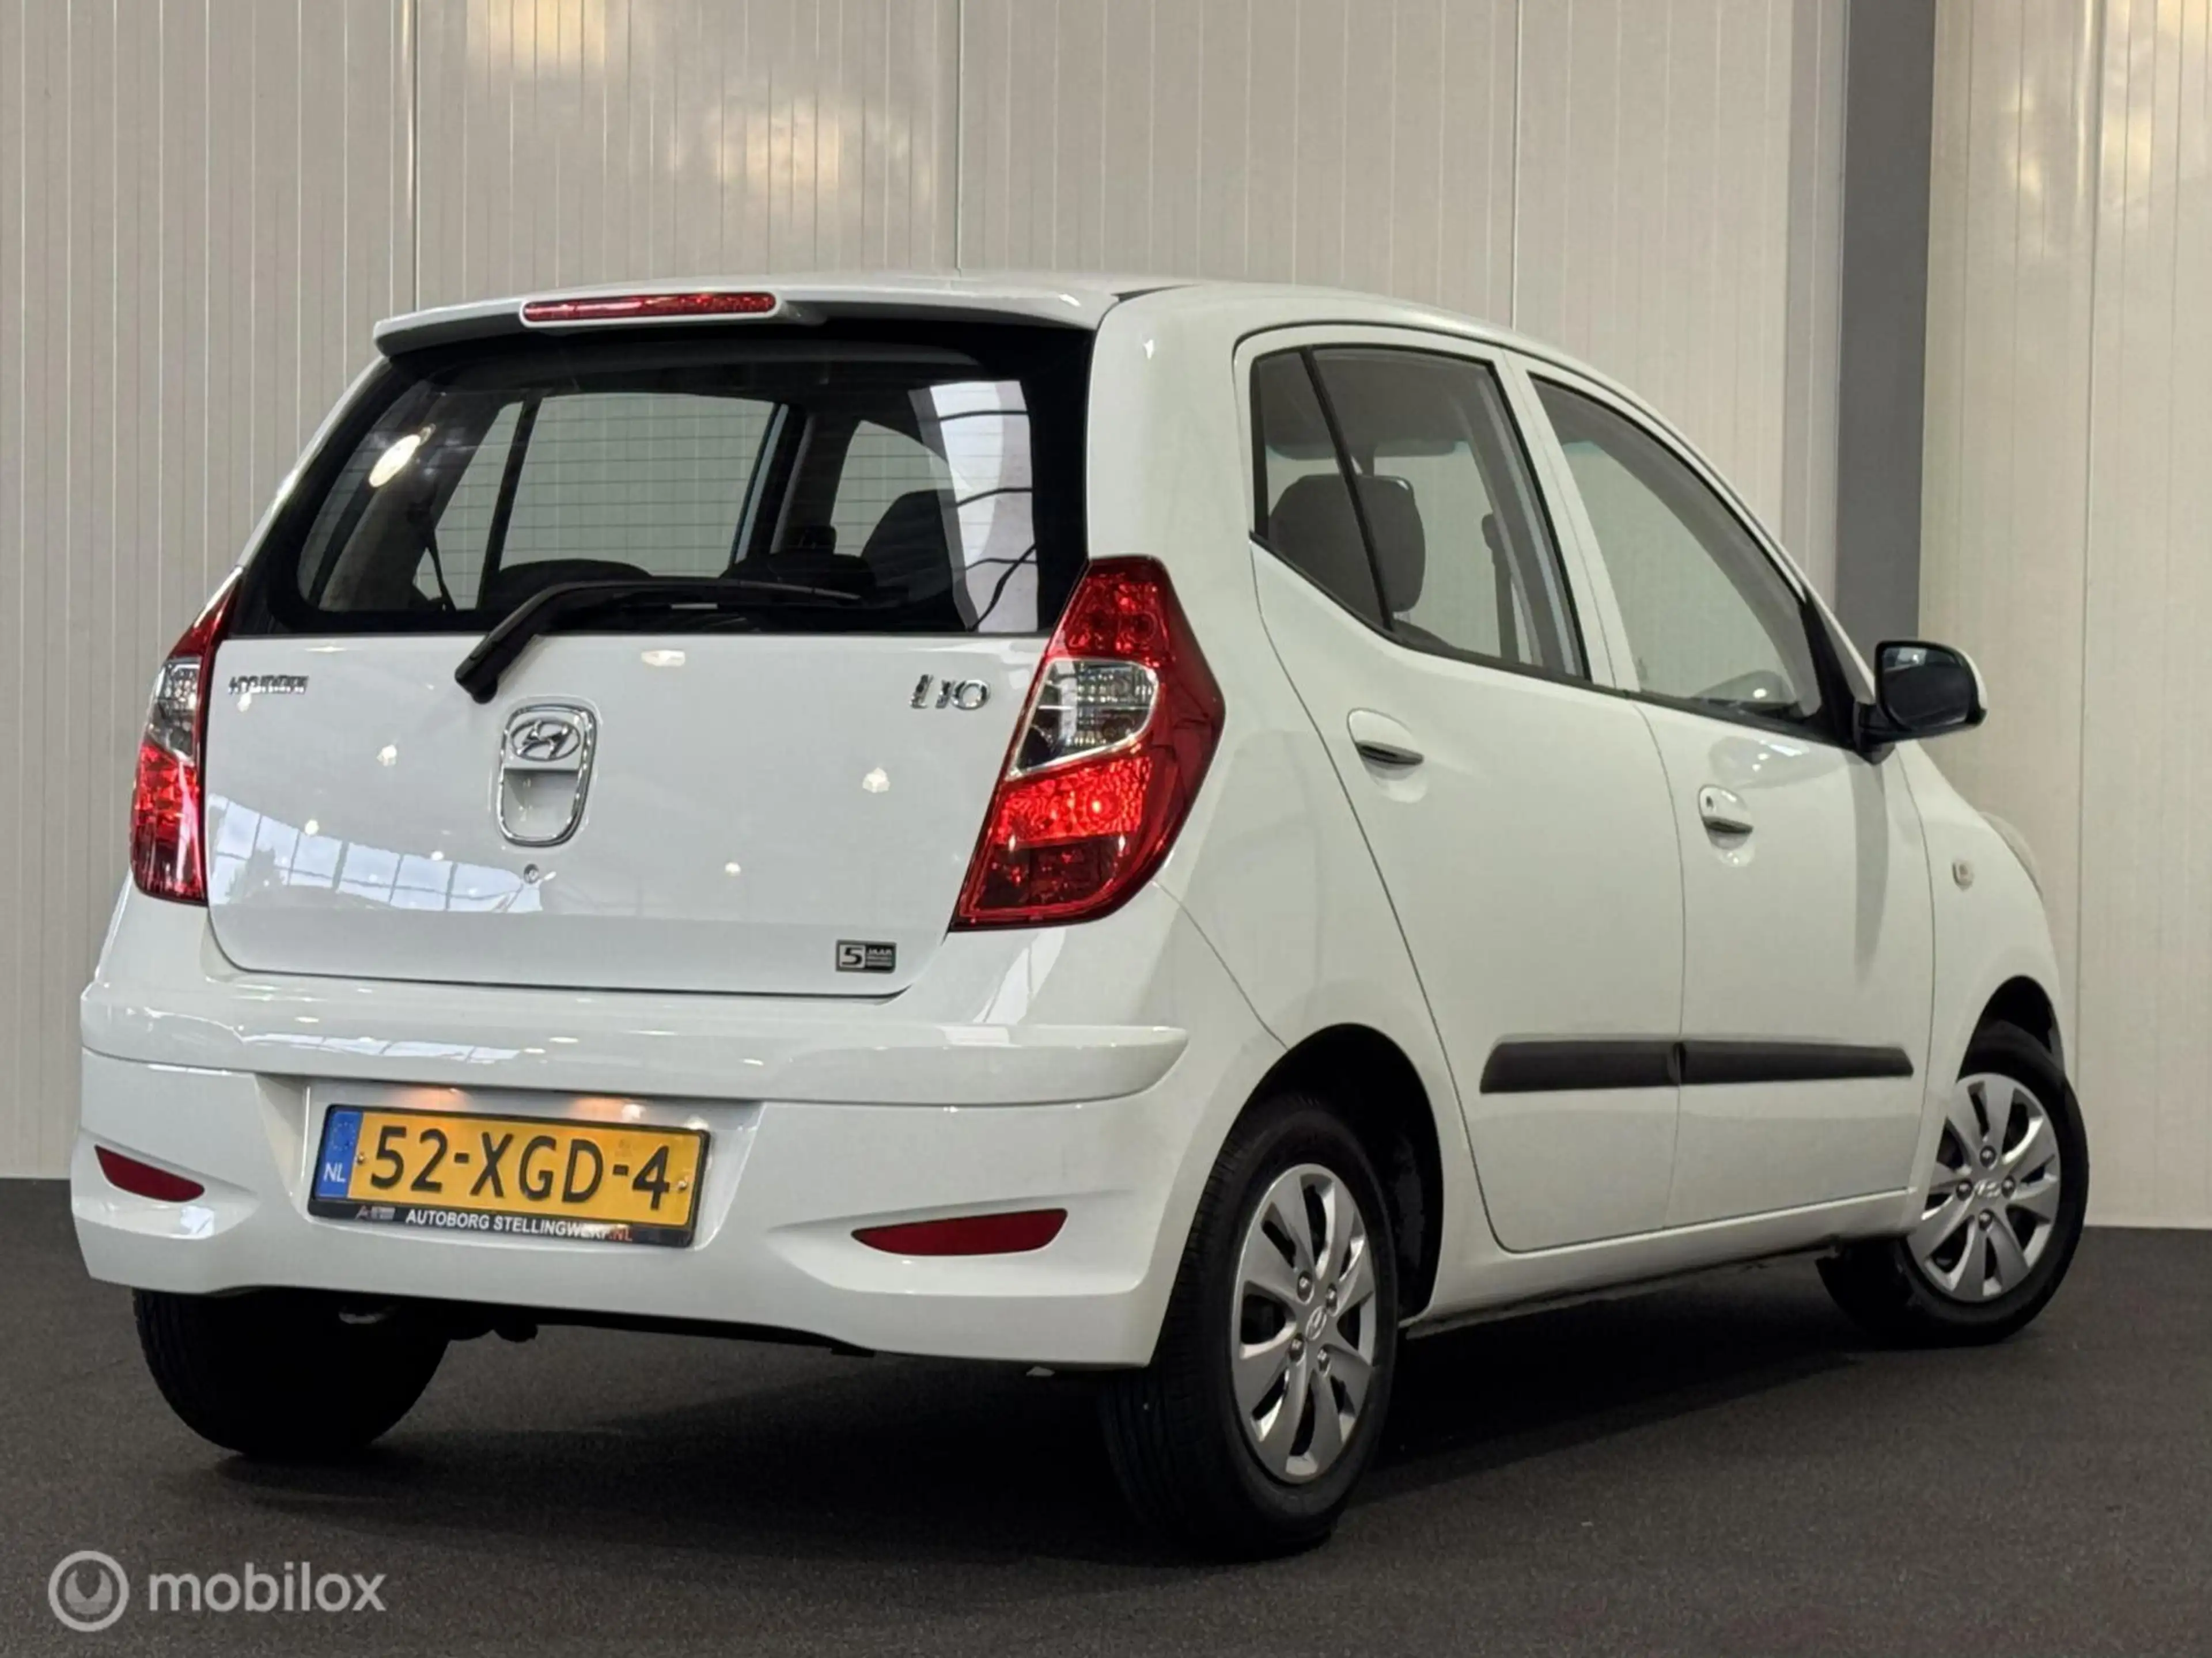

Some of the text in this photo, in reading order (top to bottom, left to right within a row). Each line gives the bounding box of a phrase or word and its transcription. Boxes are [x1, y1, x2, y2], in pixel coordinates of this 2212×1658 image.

[841, 947, 863, 966] 5
[323, 1162, 346, 1182] NL
[370, 1125, 670, 1211] 52-XGD-4
[406, 1208, 490, 1230] AUTOBORG
